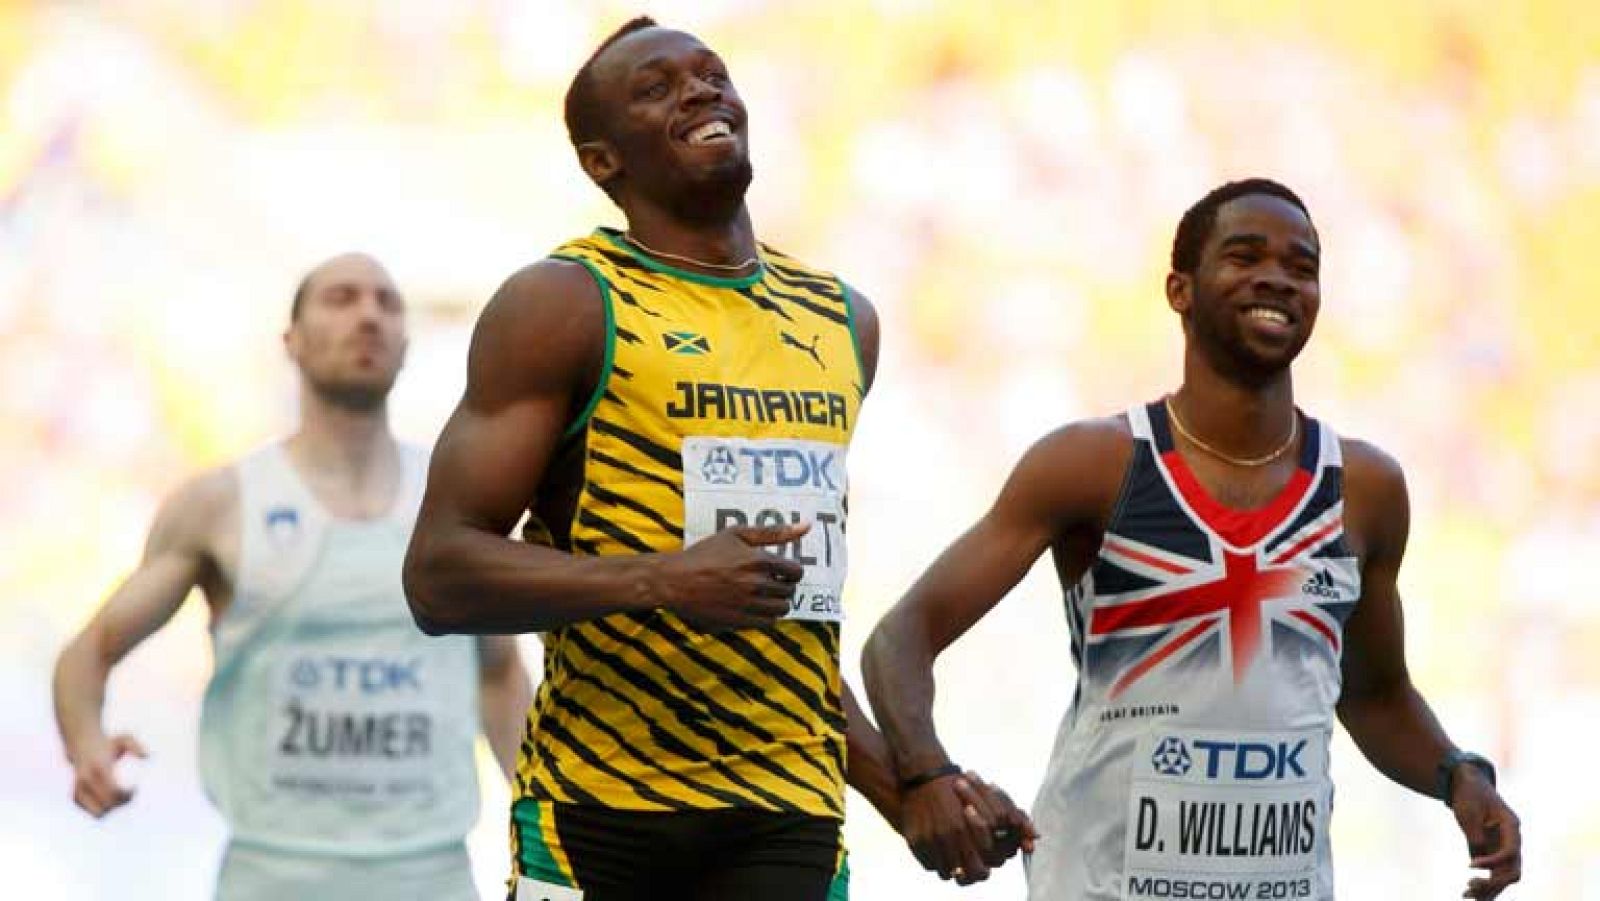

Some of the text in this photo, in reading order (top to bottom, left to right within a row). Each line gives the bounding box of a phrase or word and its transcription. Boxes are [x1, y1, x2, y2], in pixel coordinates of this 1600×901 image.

[667, 381, 847, 430] JAMAICA
[740, 448, 837, 490] TDK
[328, 658, 422, 691] TDK
[1193, 740, 1308, 779] TDK
[1135, 796, 1316, 856] D. WILLIAMS
[1129, 877, 1311, 900] MOSCOW 2013
